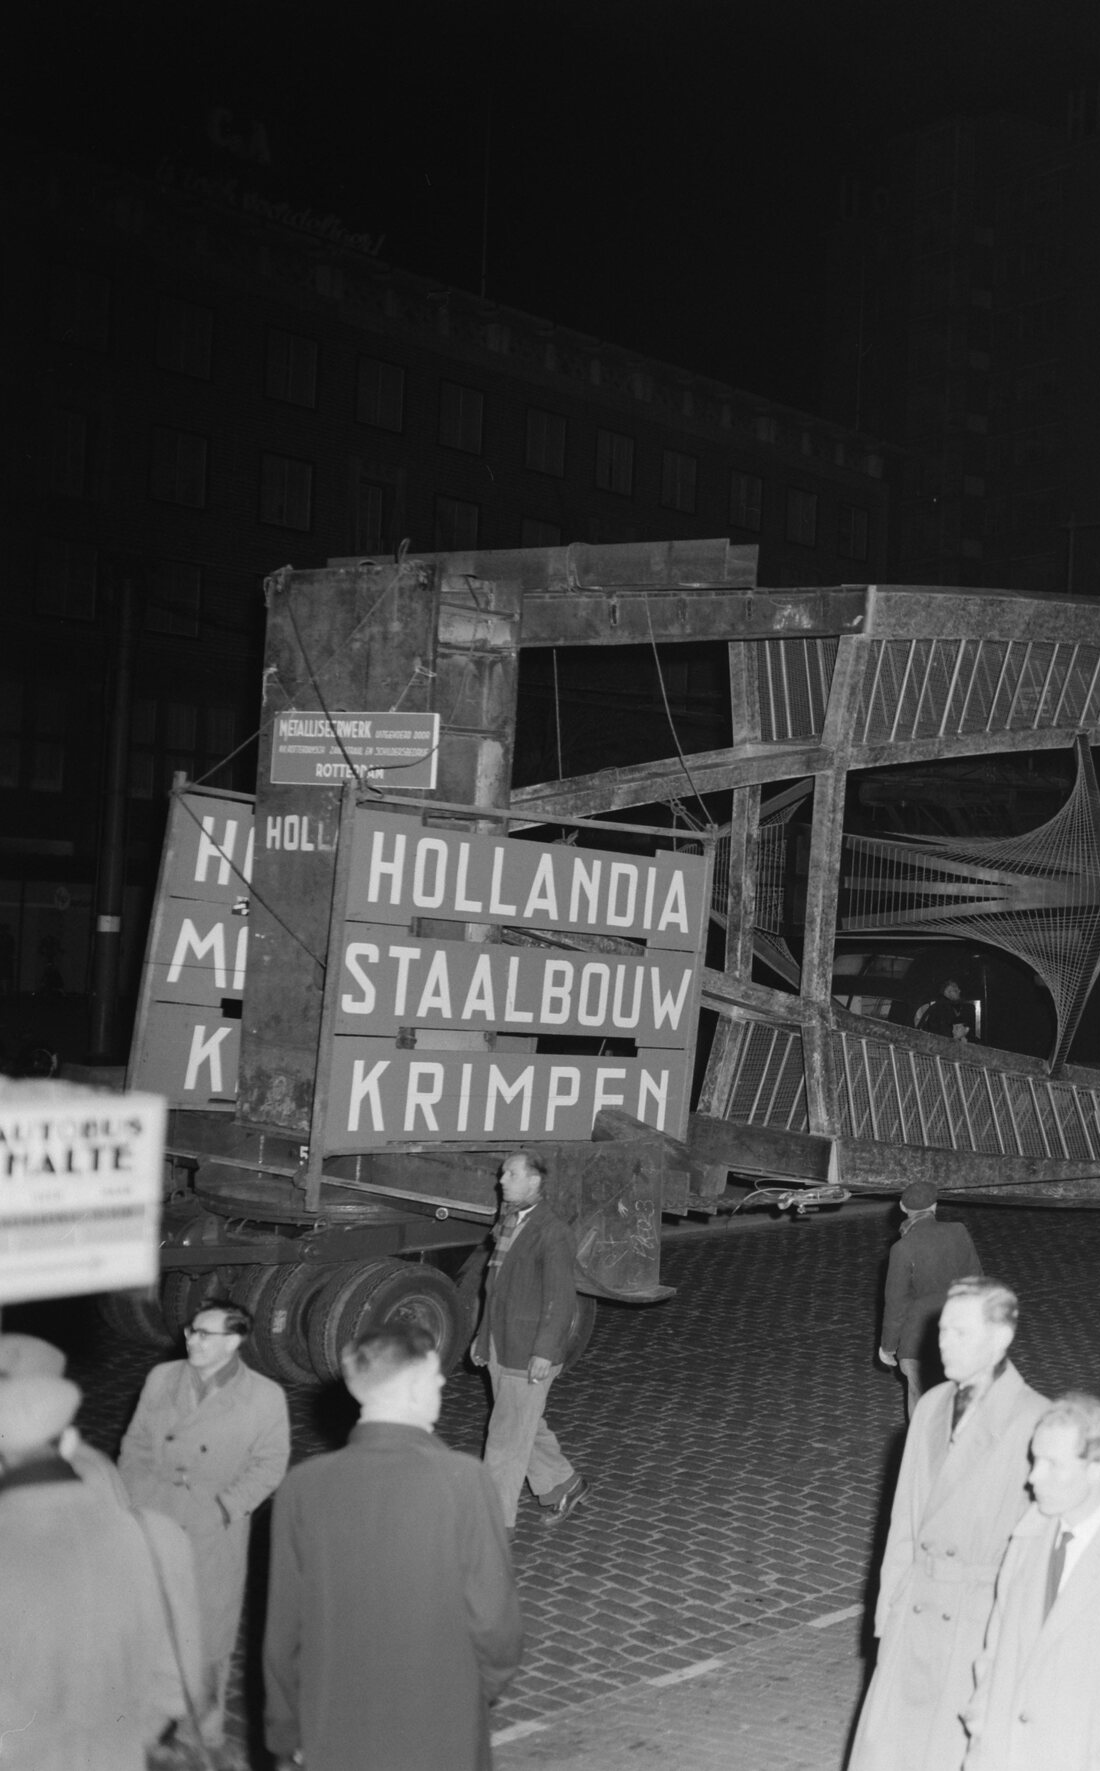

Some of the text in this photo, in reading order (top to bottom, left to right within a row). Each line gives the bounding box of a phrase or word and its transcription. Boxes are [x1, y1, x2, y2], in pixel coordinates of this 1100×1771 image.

[367, 830, 690, 934] HOLLANDIA
[341, 942, 693, 1031] STAALBOUW
[347, 1059, 670, 1132] KRIMPEN
[6, 1145, 133, 1179] HALTE
